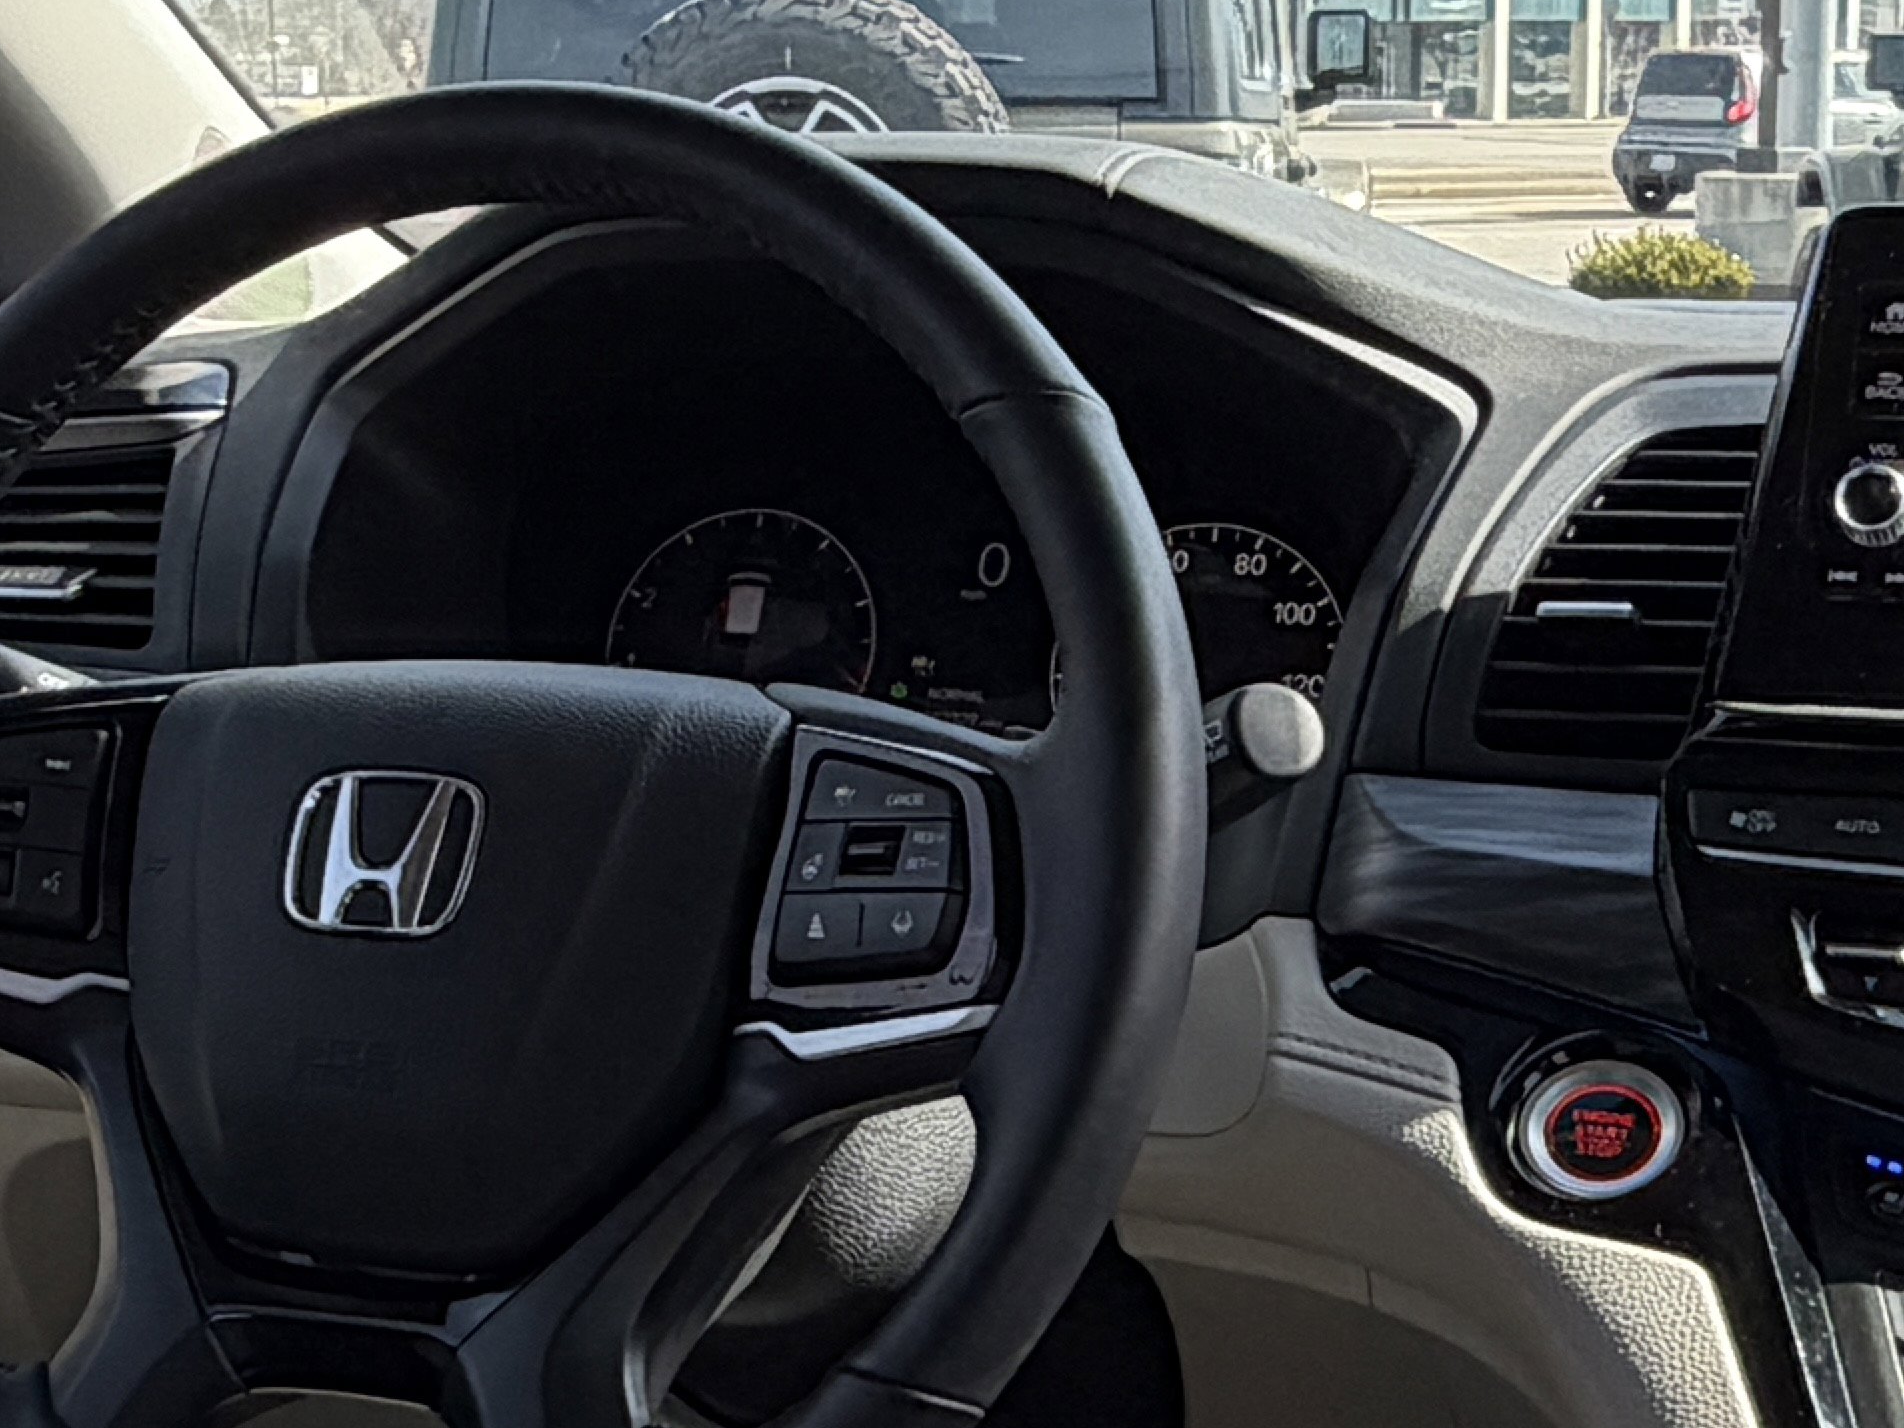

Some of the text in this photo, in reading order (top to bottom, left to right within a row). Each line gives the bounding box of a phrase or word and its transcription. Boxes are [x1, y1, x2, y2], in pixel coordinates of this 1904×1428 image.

[978, 543, 1011, 587] 0
[1234, 553, 1268, 576] 80
[1273, 602, 1316, 625] 100
[1835, 819, 1880, 834] AUTO
